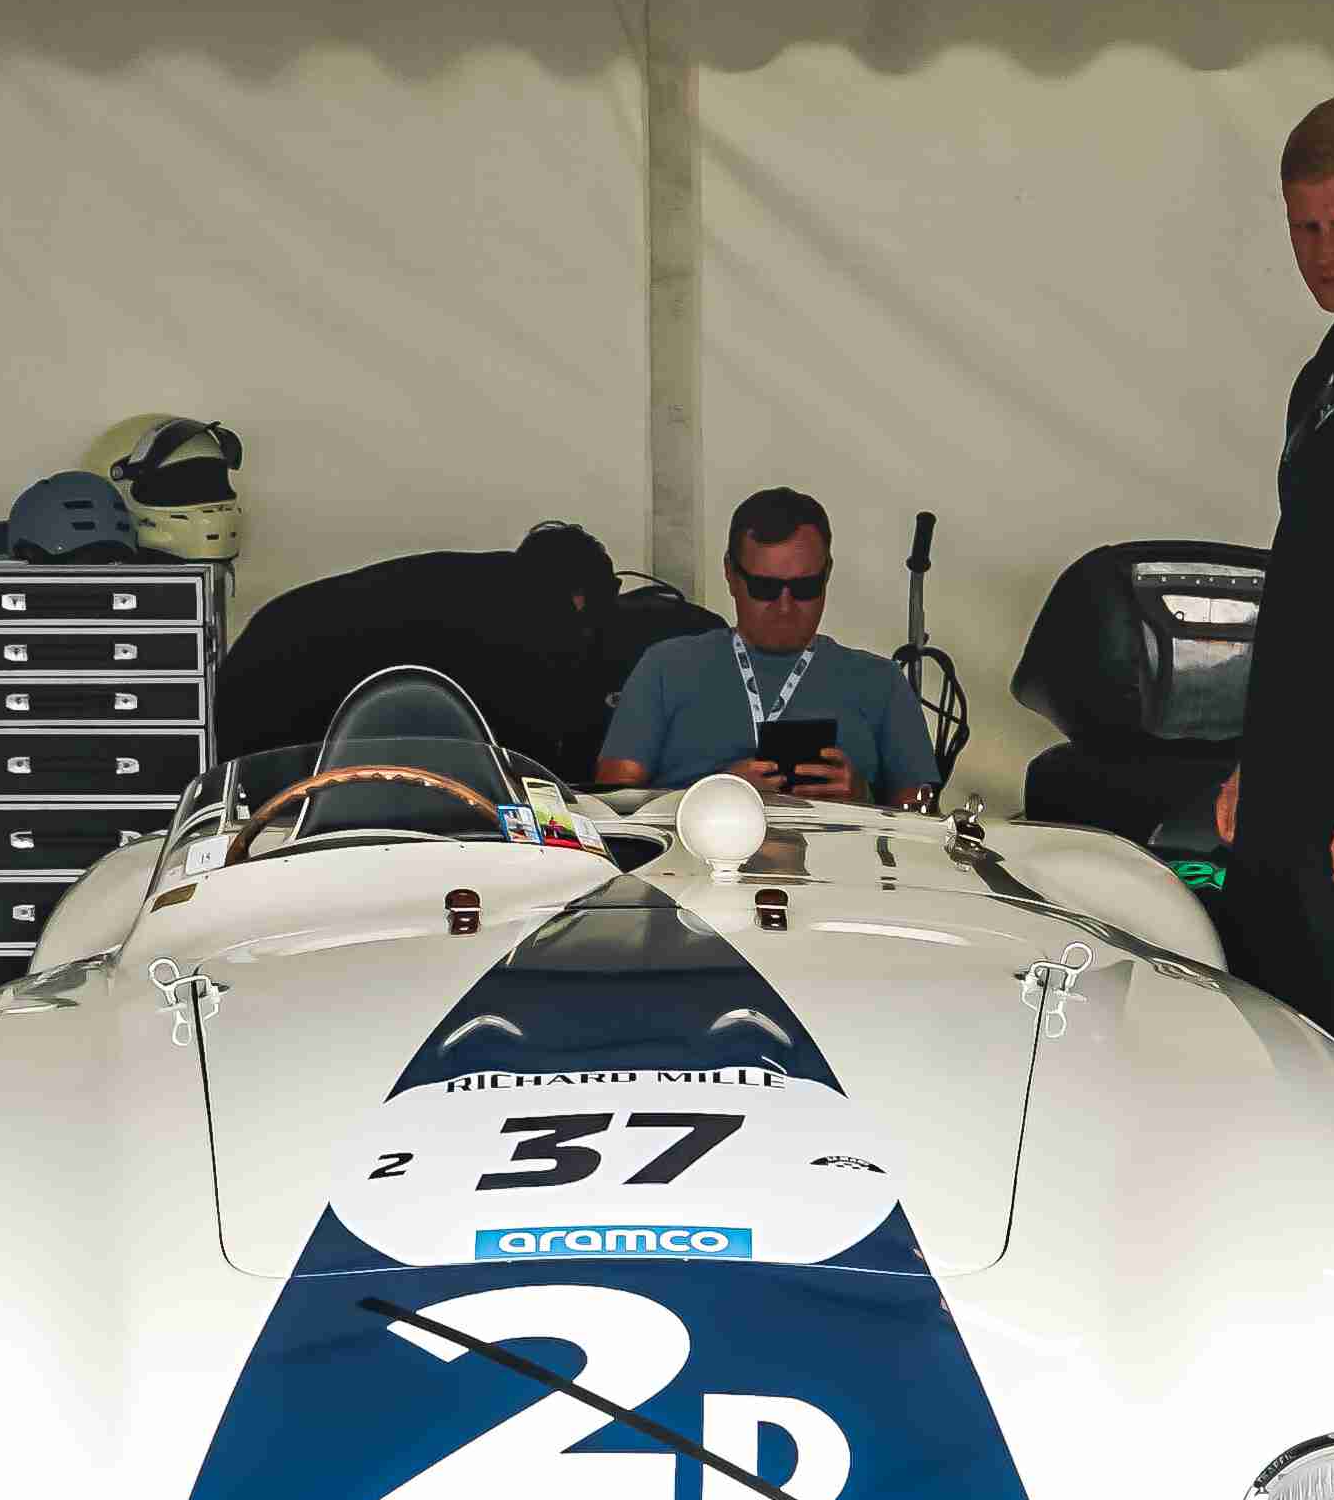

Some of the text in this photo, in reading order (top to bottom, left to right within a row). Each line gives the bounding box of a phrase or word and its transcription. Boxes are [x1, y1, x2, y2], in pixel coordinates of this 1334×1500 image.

[447, 1068, 787, 1093] RICHARD MILLE
[475, 1113, 746, 1191] 37
[368, 1152, 414, 1180] 2
[499, 1227, 730, 1253] aramco
